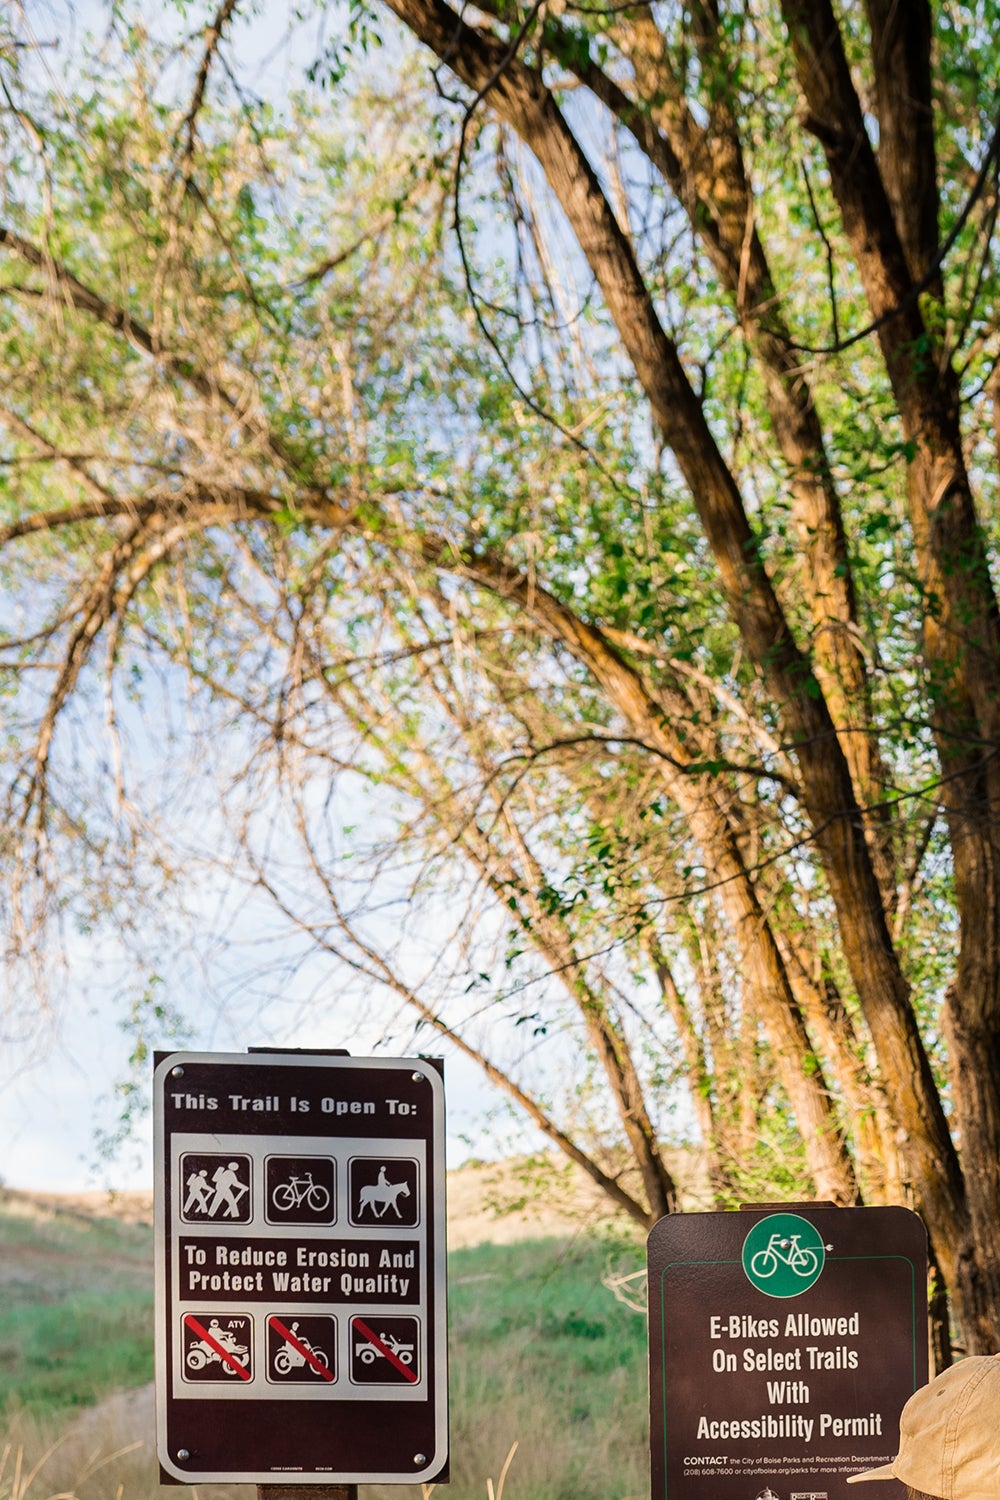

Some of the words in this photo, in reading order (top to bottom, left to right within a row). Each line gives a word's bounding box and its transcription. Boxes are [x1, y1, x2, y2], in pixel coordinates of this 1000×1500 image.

[171, 1093, 218, 1110] This
[229, 1095, 279, 1112] Trail
[290, 1097, 310, 1113] Is
[321, 1097, 376, 1116] Open
[386, 1100, 417, 1115] To:
[184, 1245, 206, 1265] To
[216, 1246, 287, 1266] Reduce
[297, 1248, 370, 1268] Erosion
[379, 1249, 415, 1269] And
[189, 1271, 263, 1292] Protect
[272, 1272, 331, 1293] Water
[341, 1273, 410, 1297] Quality
[228, 1320, 245, 1329] ATV
[710, 1314, 779, 1339] E-Bikes
[784, 1312, 860, 1337] Allowed
[712, 1349, 737, 1372] On
[743, 1348, 801, 1372] Select
[806, 1346, 859, 1370] Trails
[767, 1381, 810, 1404] With
[697, 1415, 814, 1442] Accessibility
[820, 1413, 882, 1437] Permit
[683, 1456, 728, 1465] CONTACT
[742, 1457, 754, 1466] City
[783, 1456, 801, 1464] Parks
[815, 1455, 850, 1463] Recreation
[851, 1455, 889, 1464] Department
